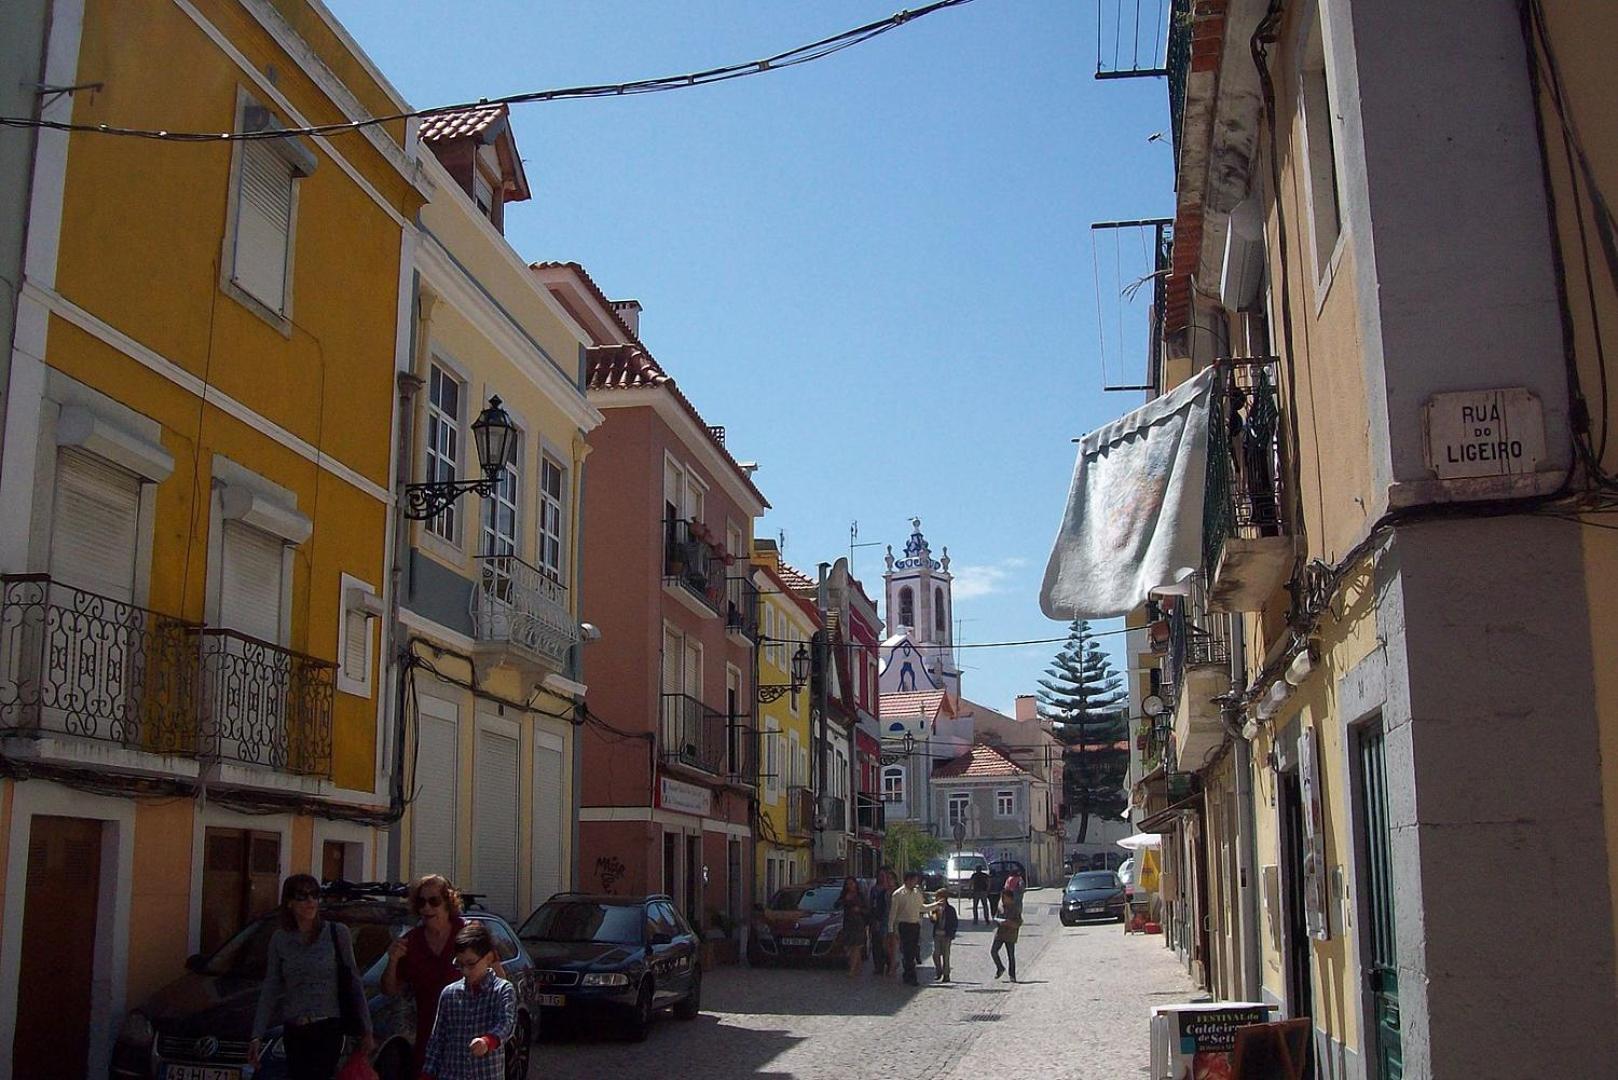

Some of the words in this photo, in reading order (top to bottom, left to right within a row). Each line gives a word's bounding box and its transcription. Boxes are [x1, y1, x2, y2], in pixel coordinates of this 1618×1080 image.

[1462, 404, 1501, 424] RUA
[1474, 427, 1492, 438] DO
[1447, 440, 1523, 463] LIGEIRO
[1197, 1013, 1244, 1022] FESTIVAL
